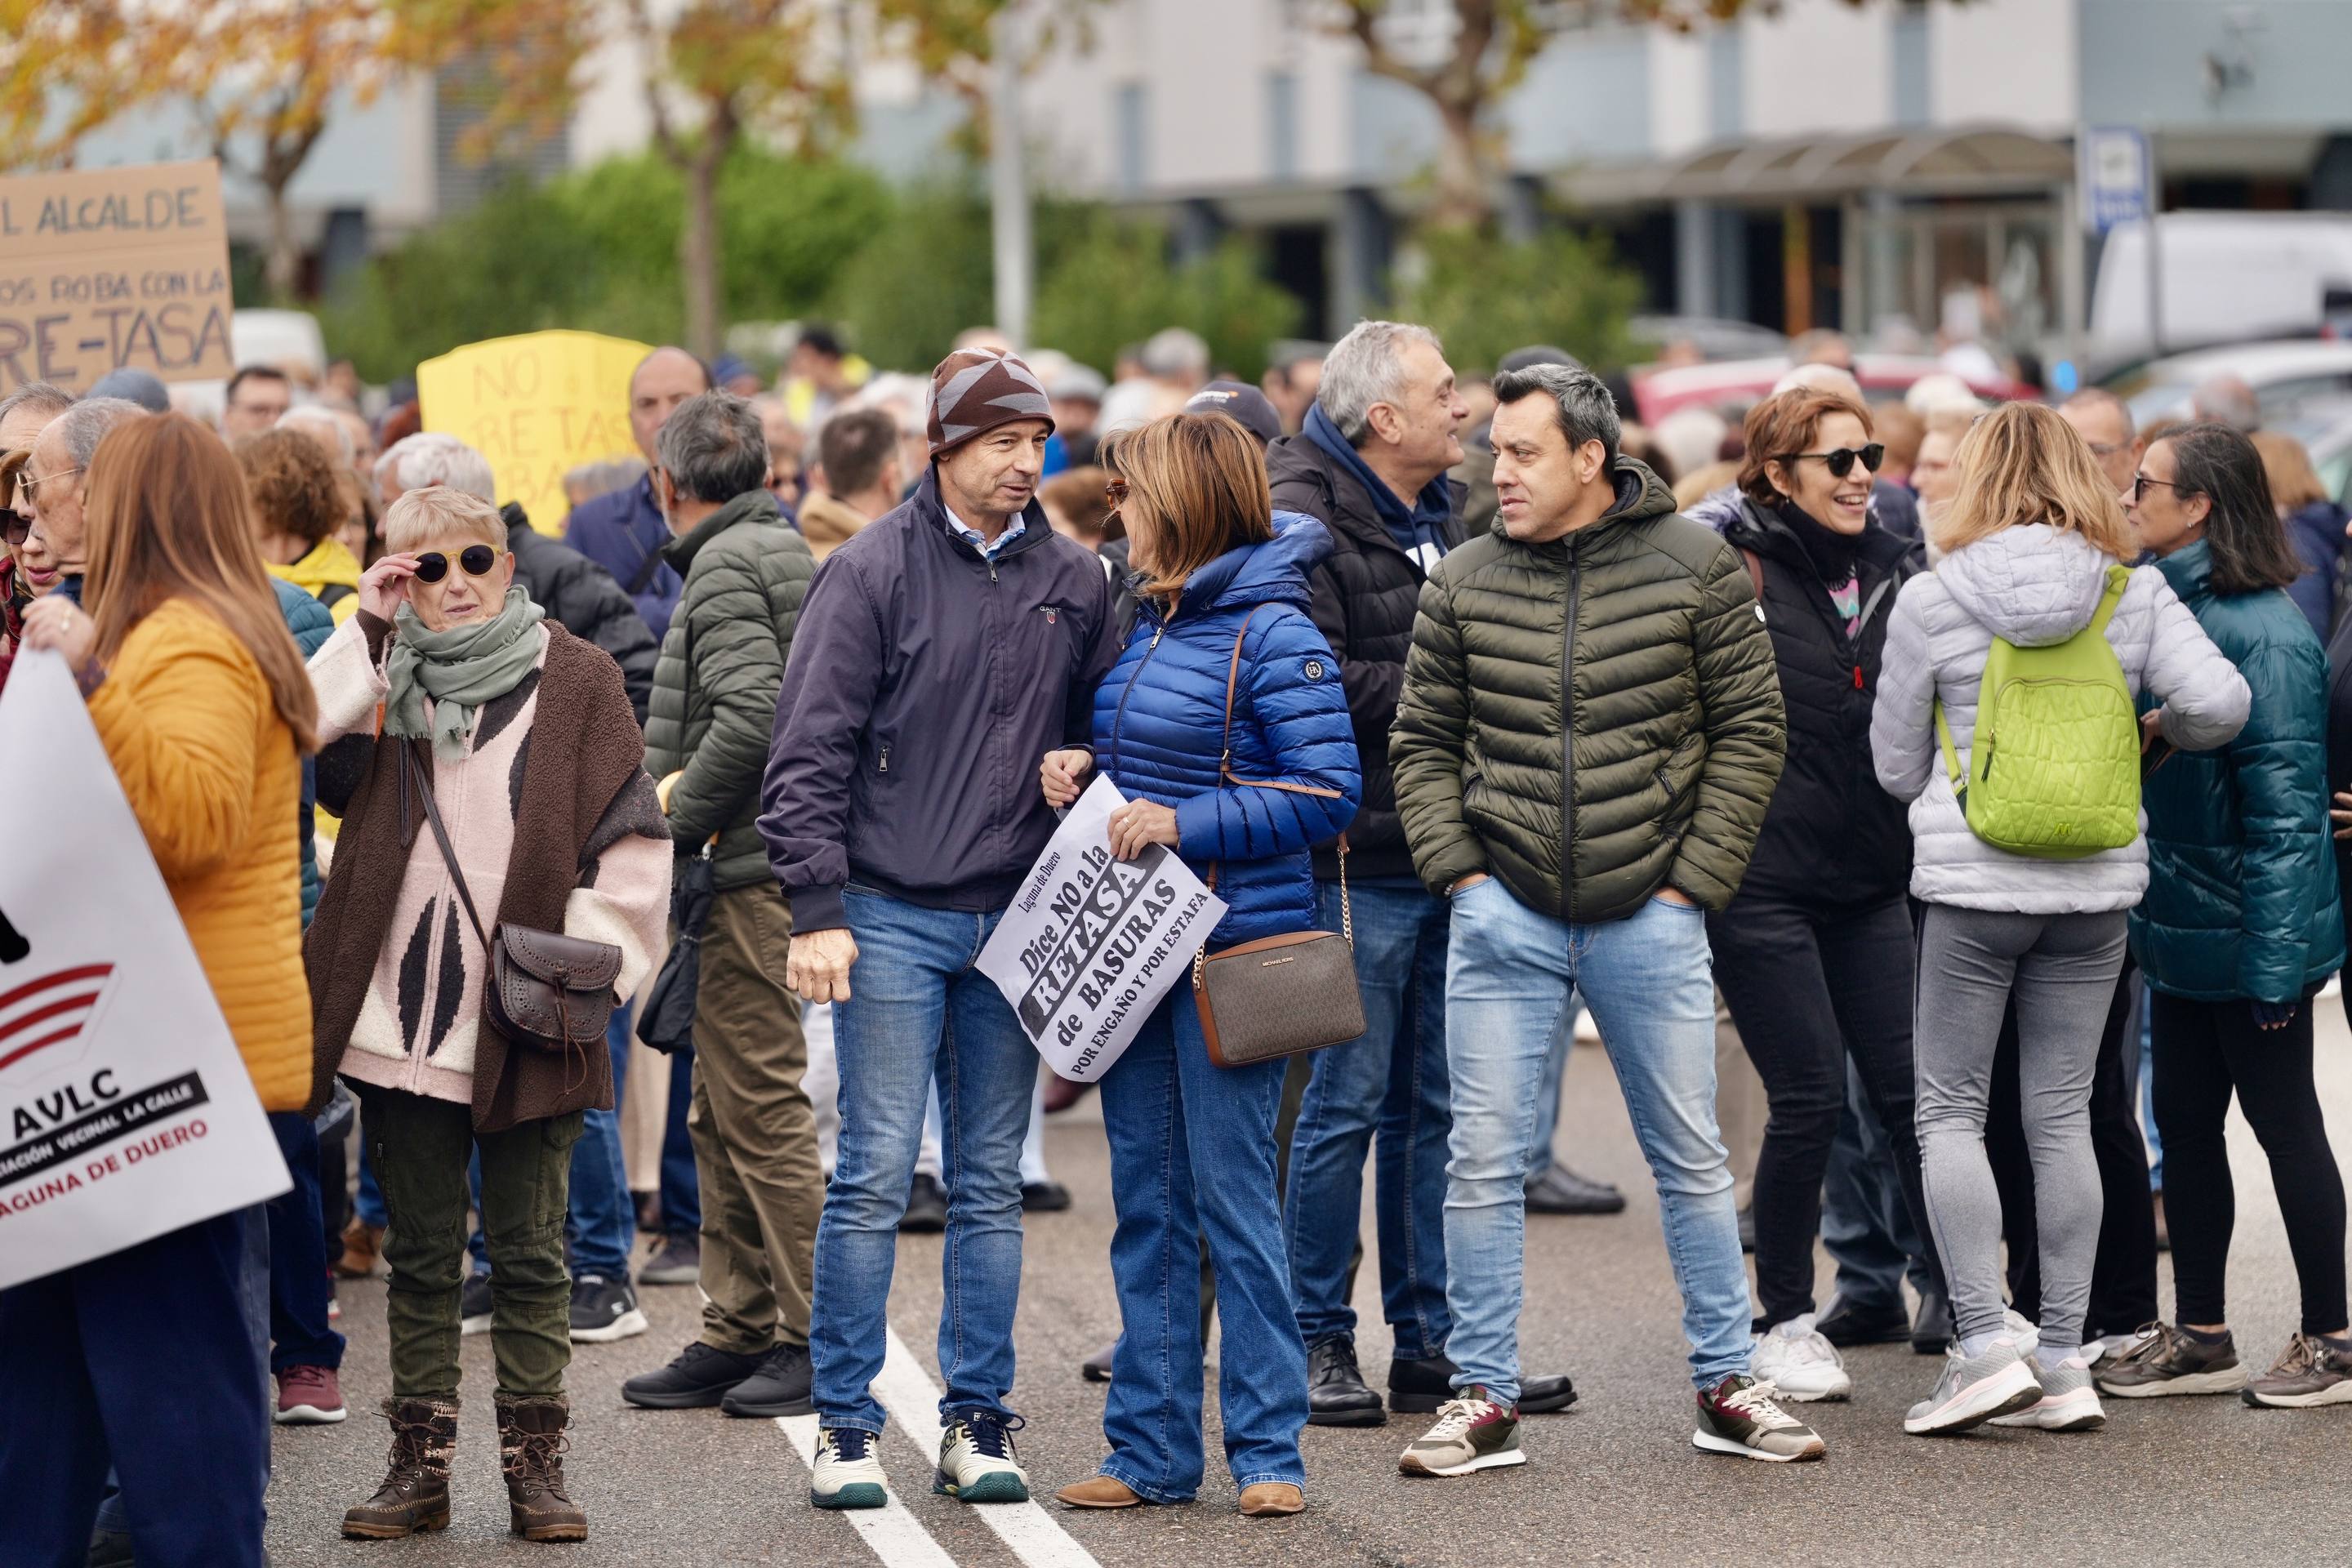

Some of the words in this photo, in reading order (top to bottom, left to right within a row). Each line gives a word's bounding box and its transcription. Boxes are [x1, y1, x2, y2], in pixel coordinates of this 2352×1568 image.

[37, 185, 206, 235] ALCALDE
[51, 271, 132, 303] ROBA
[140, 270, 188, 299] CON
[194, 266, 225, 297] LA
[472, 348, 541, 406] NO
[549, 404, 633, 455] TAS
[1036, 875, 1048, 887] de
[1040, 851, 1061, 877] Duero
[1077, 870, 1094, 889] a
[1081, 845, 1108, 873] la
[1018, 884, 1042, 913] Laguna
[1050, 882, 1081, 926] NO
[1020, 924, 1058, 978] Dice
[1031, 862, 1146, 1017] RETASA
[1057, 1013, 1083, 1047] de
[1077, 879, 1176, 1011] BASURAS
[1071, 1048, 1098, 1076] POR
[1090, 987, 1138, 1049] ENGAÑO
[1132, 973, 1146, 990] Y
[1142, 951, 1169, 980] POR
[1164, 892, 1209, 948] ESTAFA
[13, 1068, 121, 1139] AVLC
[56, 1113, 122, 1152] VECINAL
[123, 1102, 146, 1122] LA
[145, 1083, 194, 1111] CALLE
[87, 1153, 121, 1182] DE
[123, 1119, 208, 1165] DUERO
